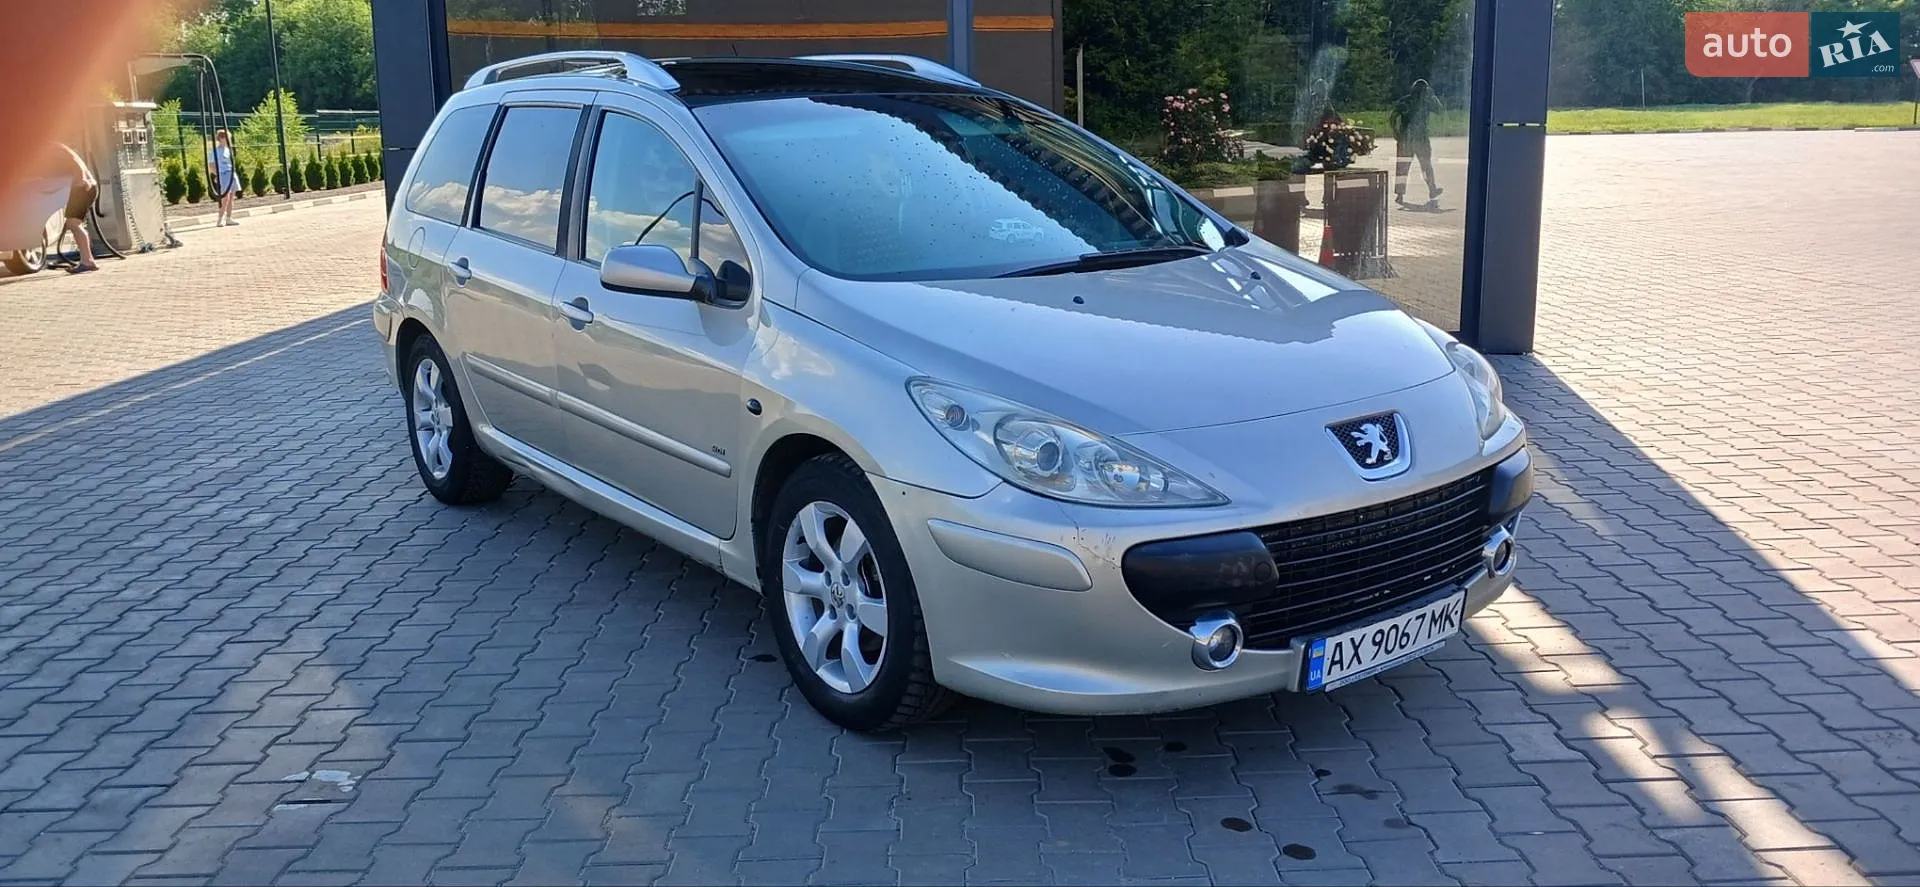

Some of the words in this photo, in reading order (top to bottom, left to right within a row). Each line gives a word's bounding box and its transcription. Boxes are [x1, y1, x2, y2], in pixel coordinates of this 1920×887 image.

[1327, 633, 1366, 676] AX
[1371, 613, 1426, 660] 9067
[1427, 600, 1461, 639] MK
[1310, 670, 1322, 681] UA
